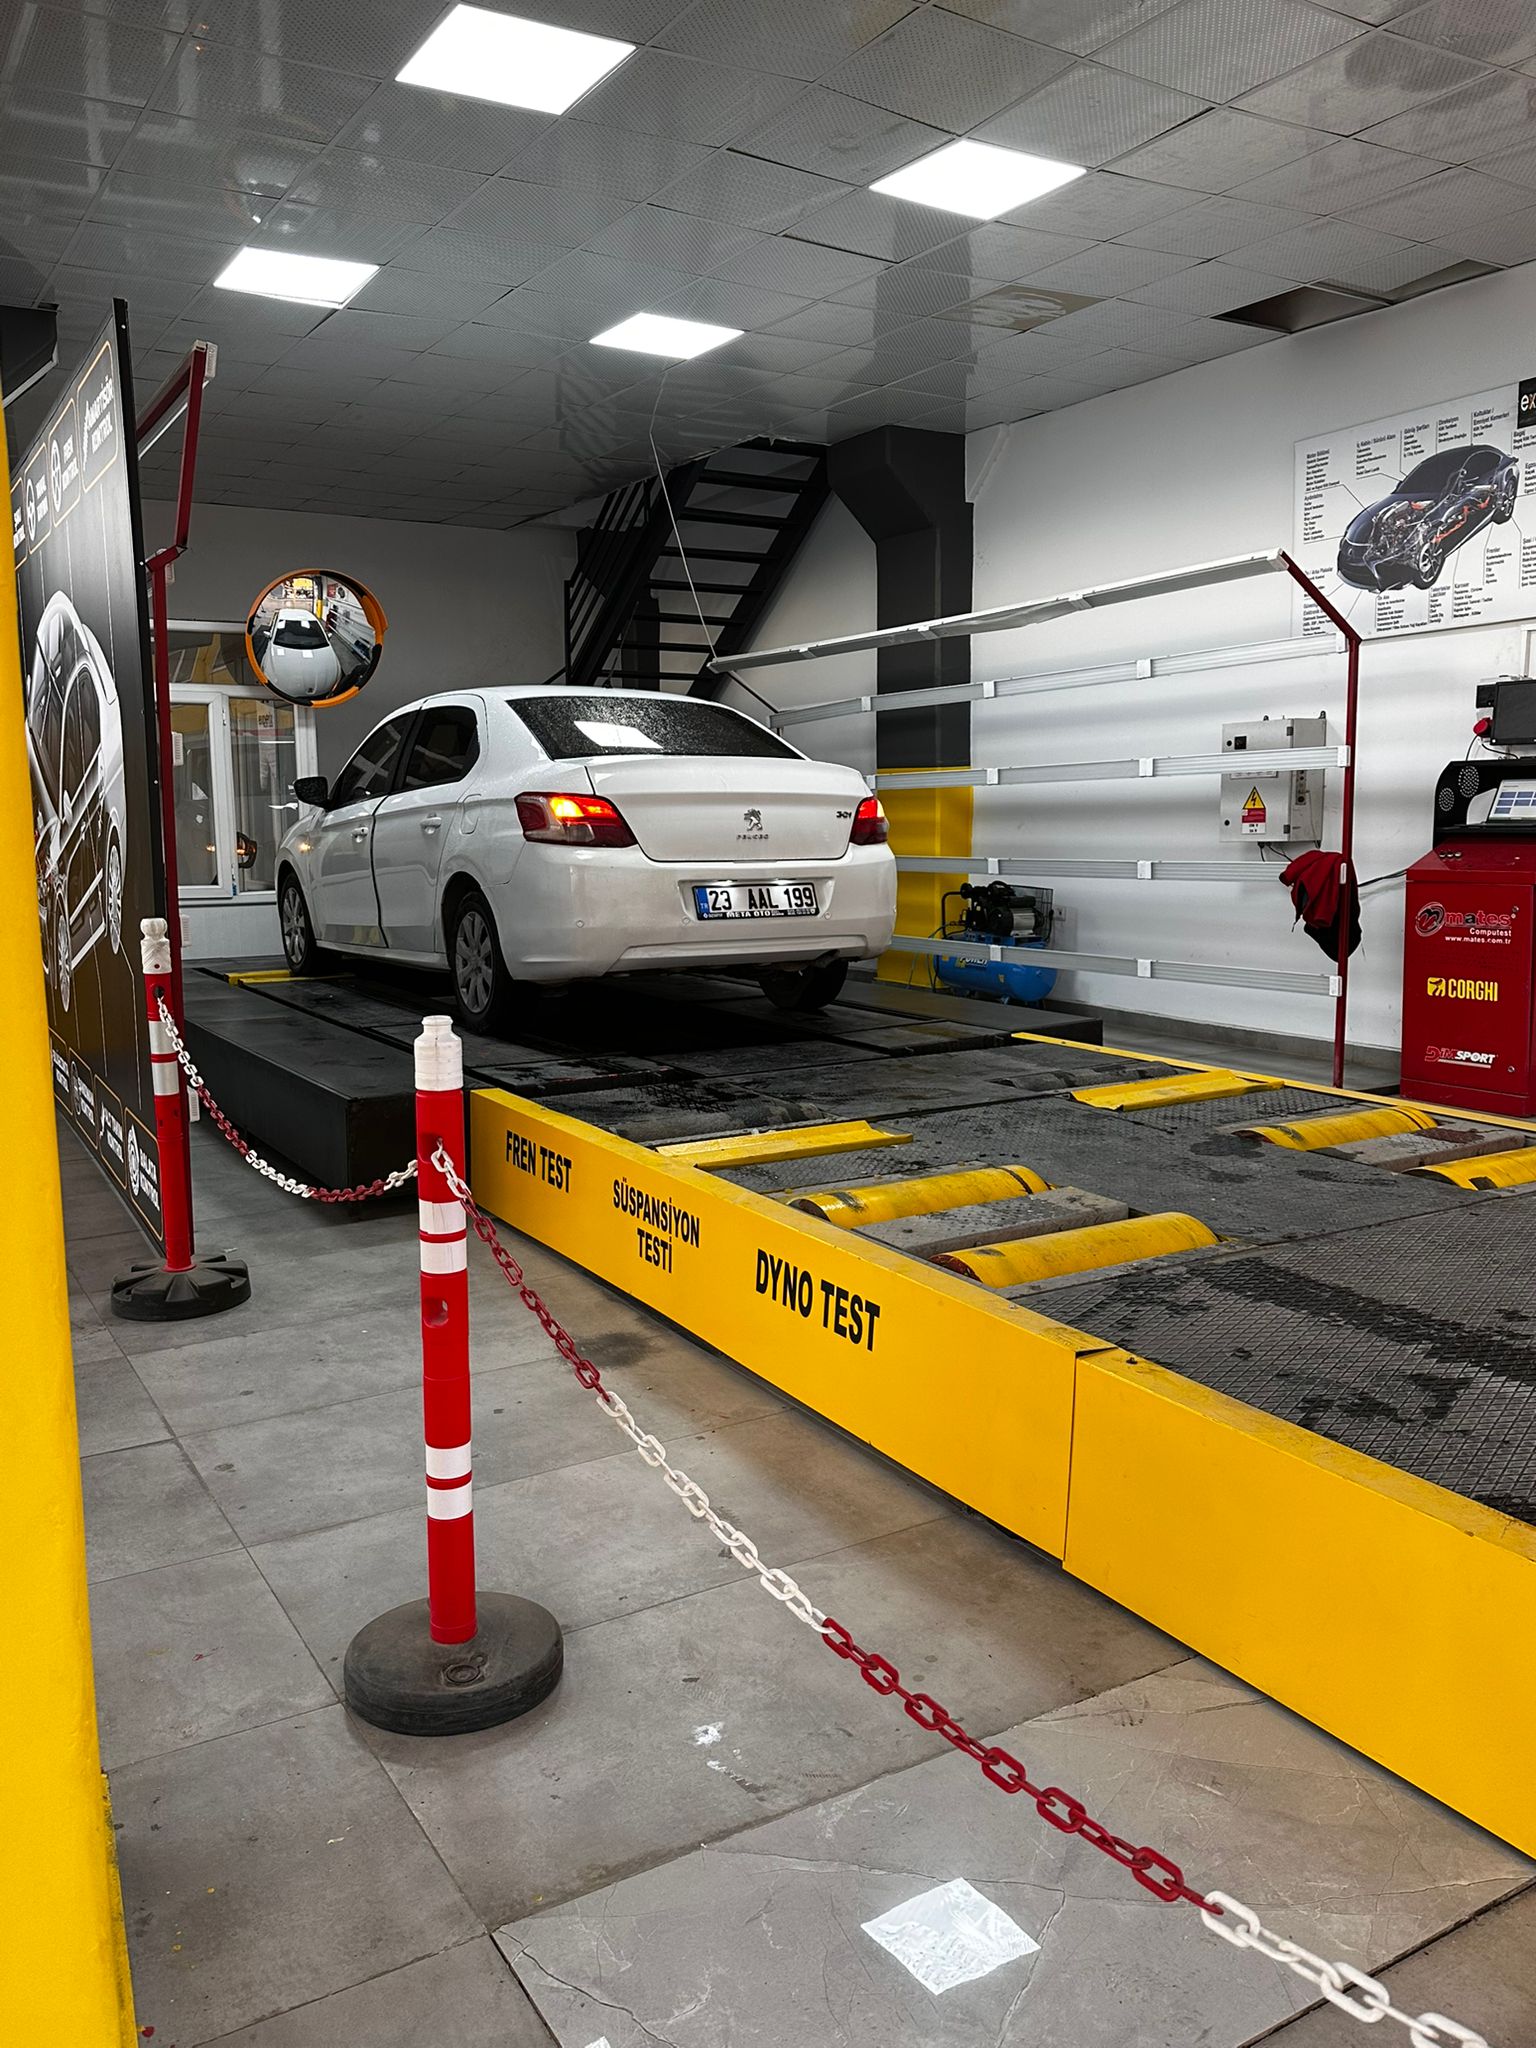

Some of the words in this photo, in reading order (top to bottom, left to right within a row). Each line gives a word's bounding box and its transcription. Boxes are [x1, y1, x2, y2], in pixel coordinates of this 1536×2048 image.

[709, 890, 732, 911] 23
[748, 887, 779, 909] AAL
[783, 887, 814, 908] 199
[726, 910, 752, 918] META
[1445, 910, 1511, 926] mates
[1444, 935, 1511, 945] www.mates.com.tr
[1469, 927, 1512, 937] Computest
[1448, 978, 1499, 1002] CORGHI
[506, 1130, 536, 1176] FREN
[540, 1145, 572, 1193] TEST
[613, 1177, 700, 1248] SÜSPANSİYON
[637, 1228, 673, 1274] TESTİ
[756, 1248, 814, 1318] DYNO
[820, 1279, 880, 1352] TEST
